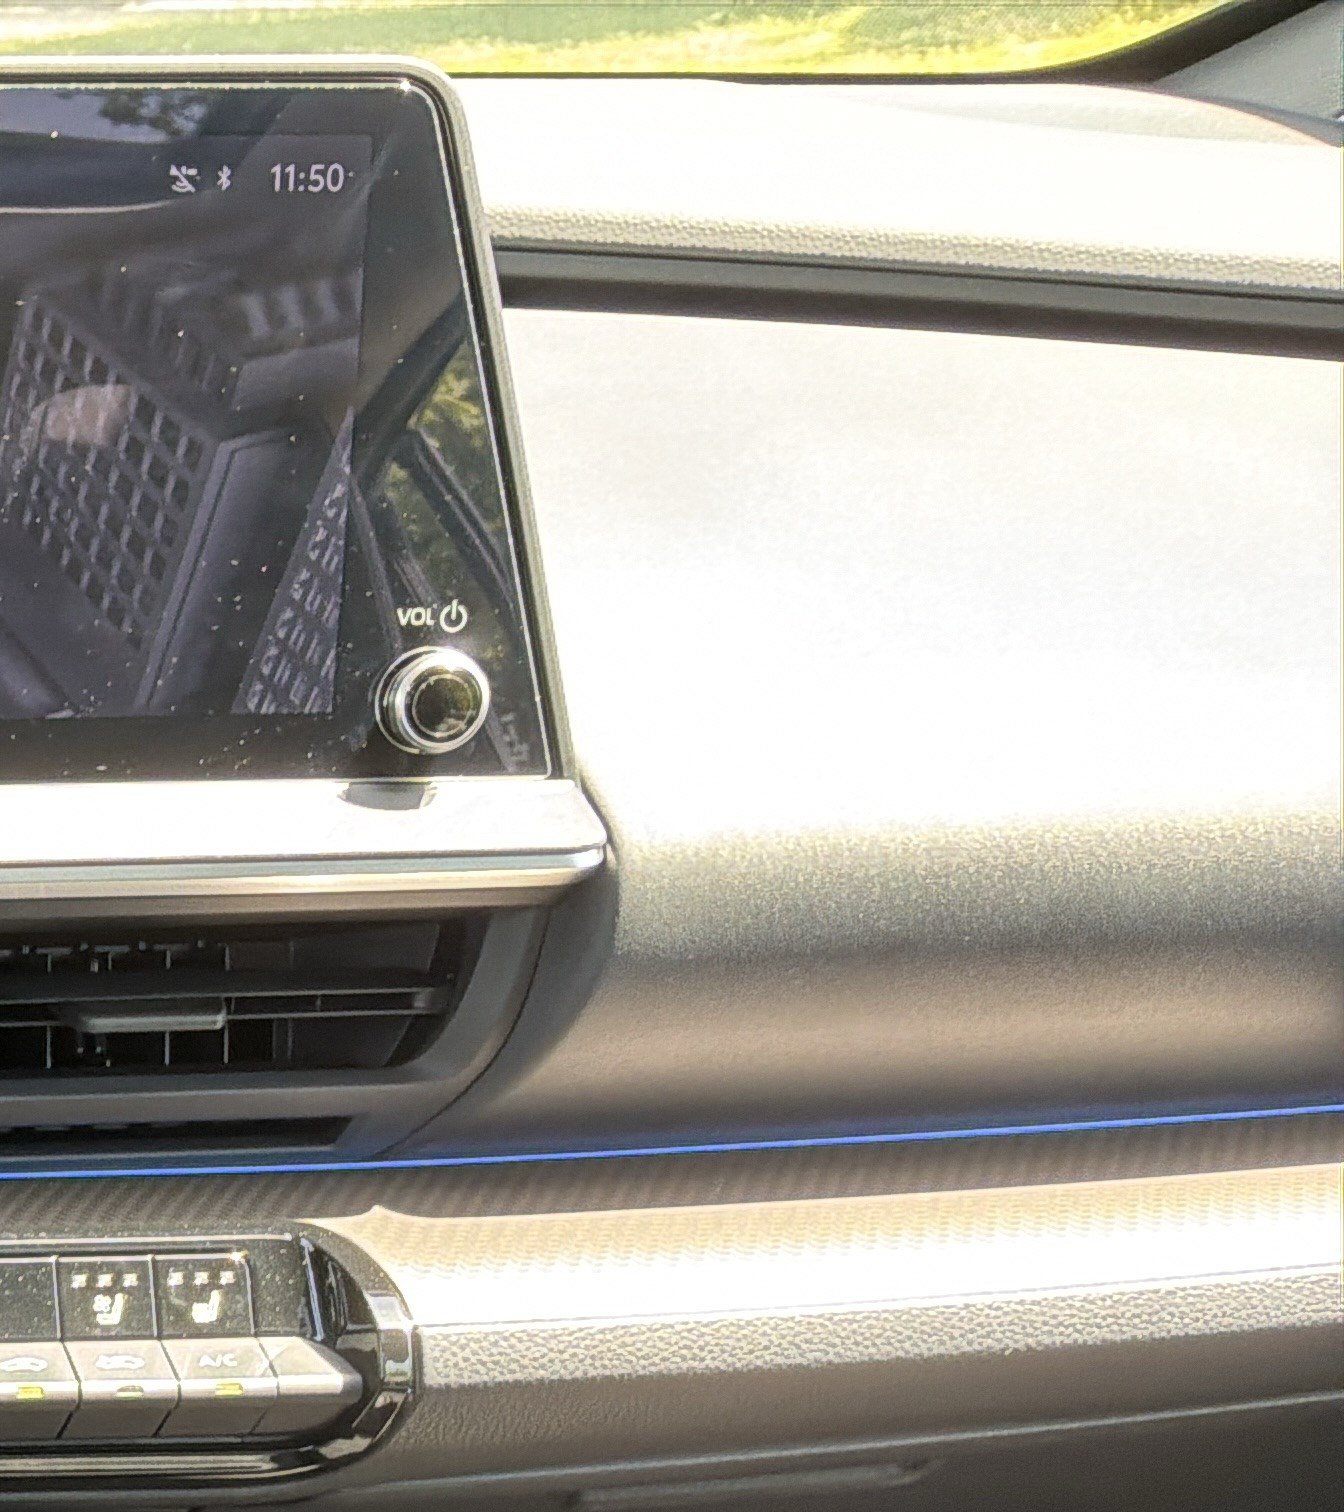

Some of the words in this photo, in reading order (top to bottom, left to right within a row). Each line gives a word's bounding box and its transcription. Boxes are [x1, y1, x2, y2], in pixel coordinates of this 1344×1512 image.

[270, 162, 345, 193] 11:50
[396, 606, 435, 627] VOL
[198, 1353, 238, 1368] A/C
